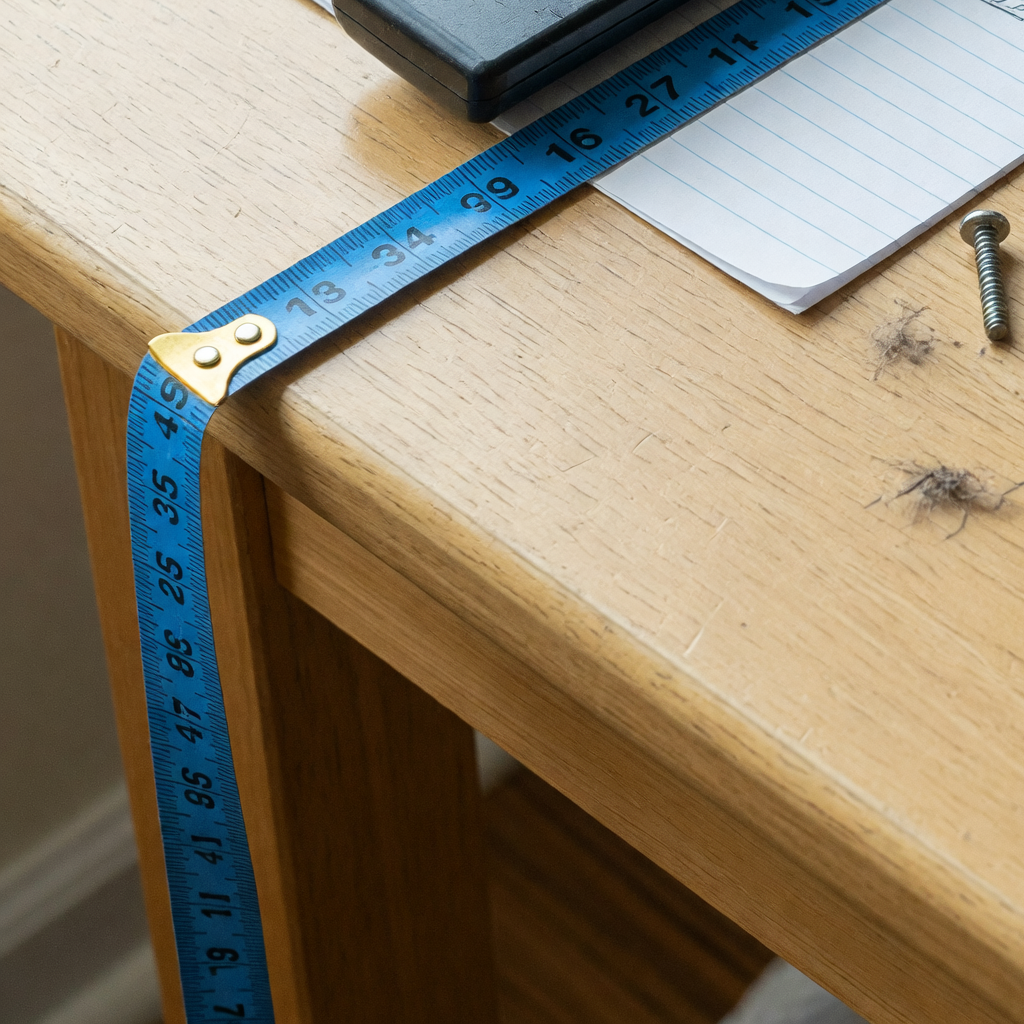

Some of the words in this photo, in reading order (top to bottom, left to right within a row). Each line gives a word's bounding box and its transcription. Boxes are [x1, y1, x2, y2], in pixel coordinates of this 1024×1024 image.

[285, 281, 346, 317] 13
[371, 226, 437, 267] 34
[545, 128, 603, 163] 16
[625, 75, 680, 118] 27
[152, 468, 179, 526] 35
[155, 550, 185, 606] 25
[171, 696, 203, 744] 47
